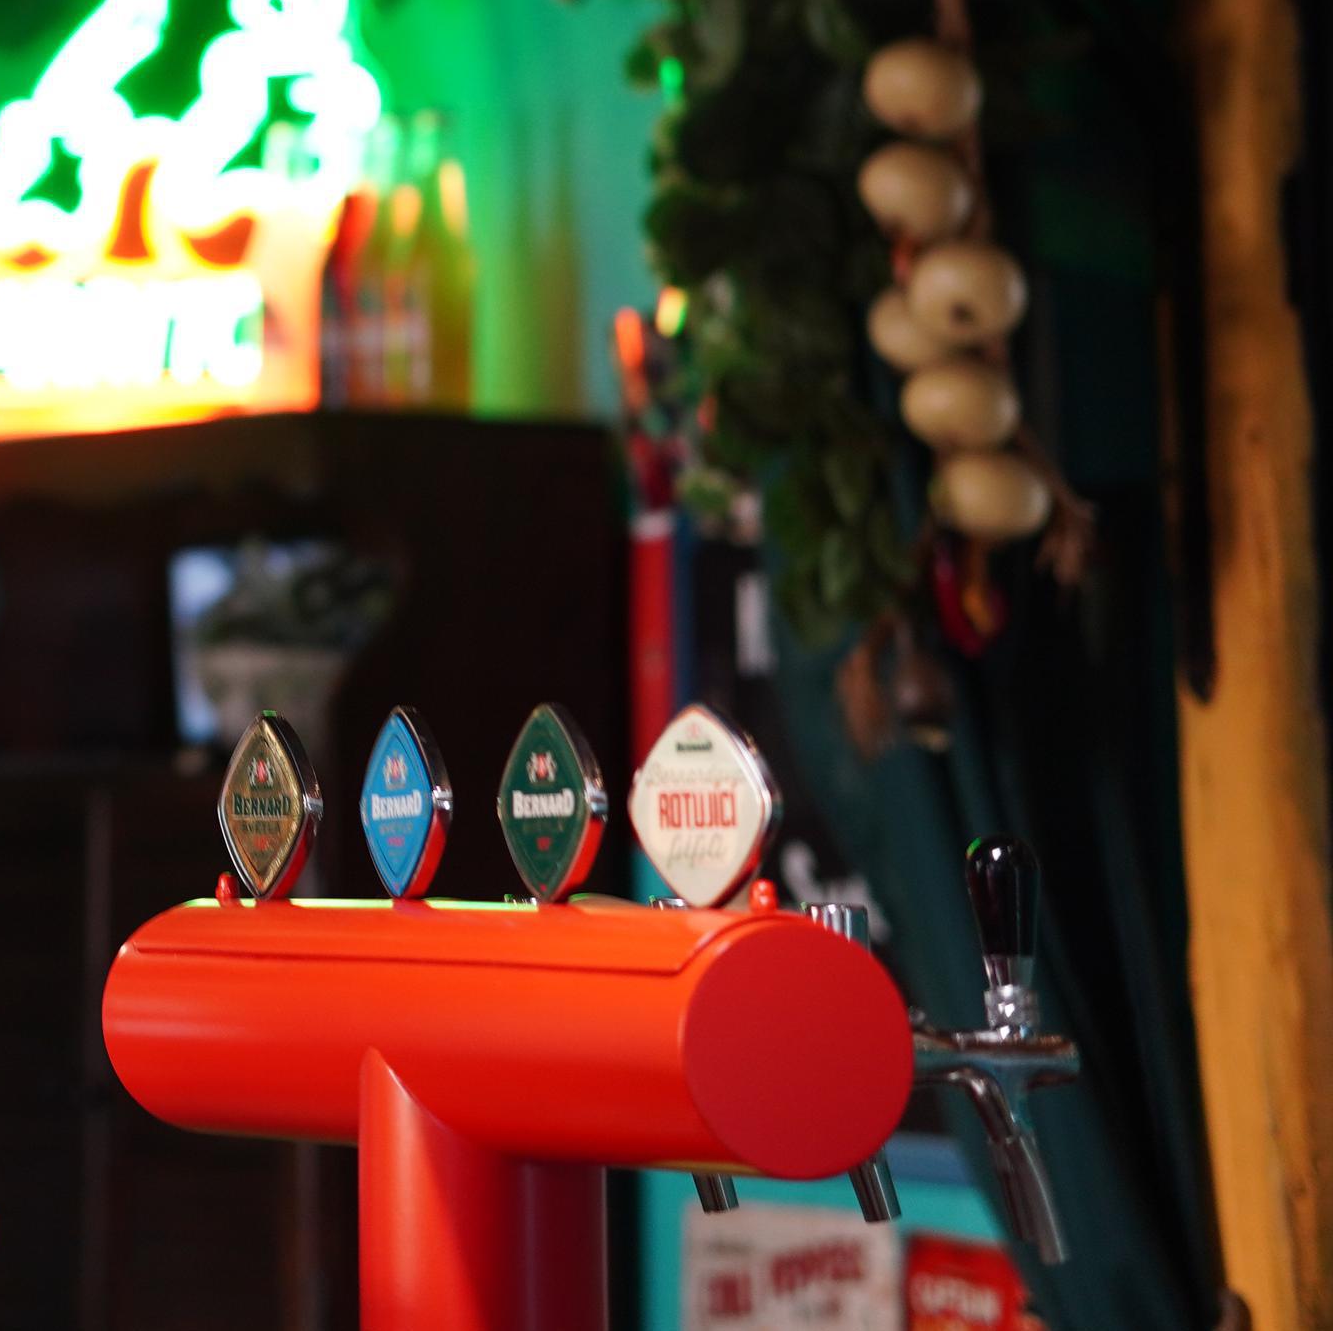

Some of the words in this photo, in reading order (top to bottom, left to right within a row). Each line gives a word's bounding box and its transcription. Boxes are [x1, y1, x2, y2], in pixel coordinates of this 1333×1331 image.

[233, 792, 292, 817] BERNARD
[371, 789, 423, 820] BERNARD
[512, 787, 575, 819] BERNARD
